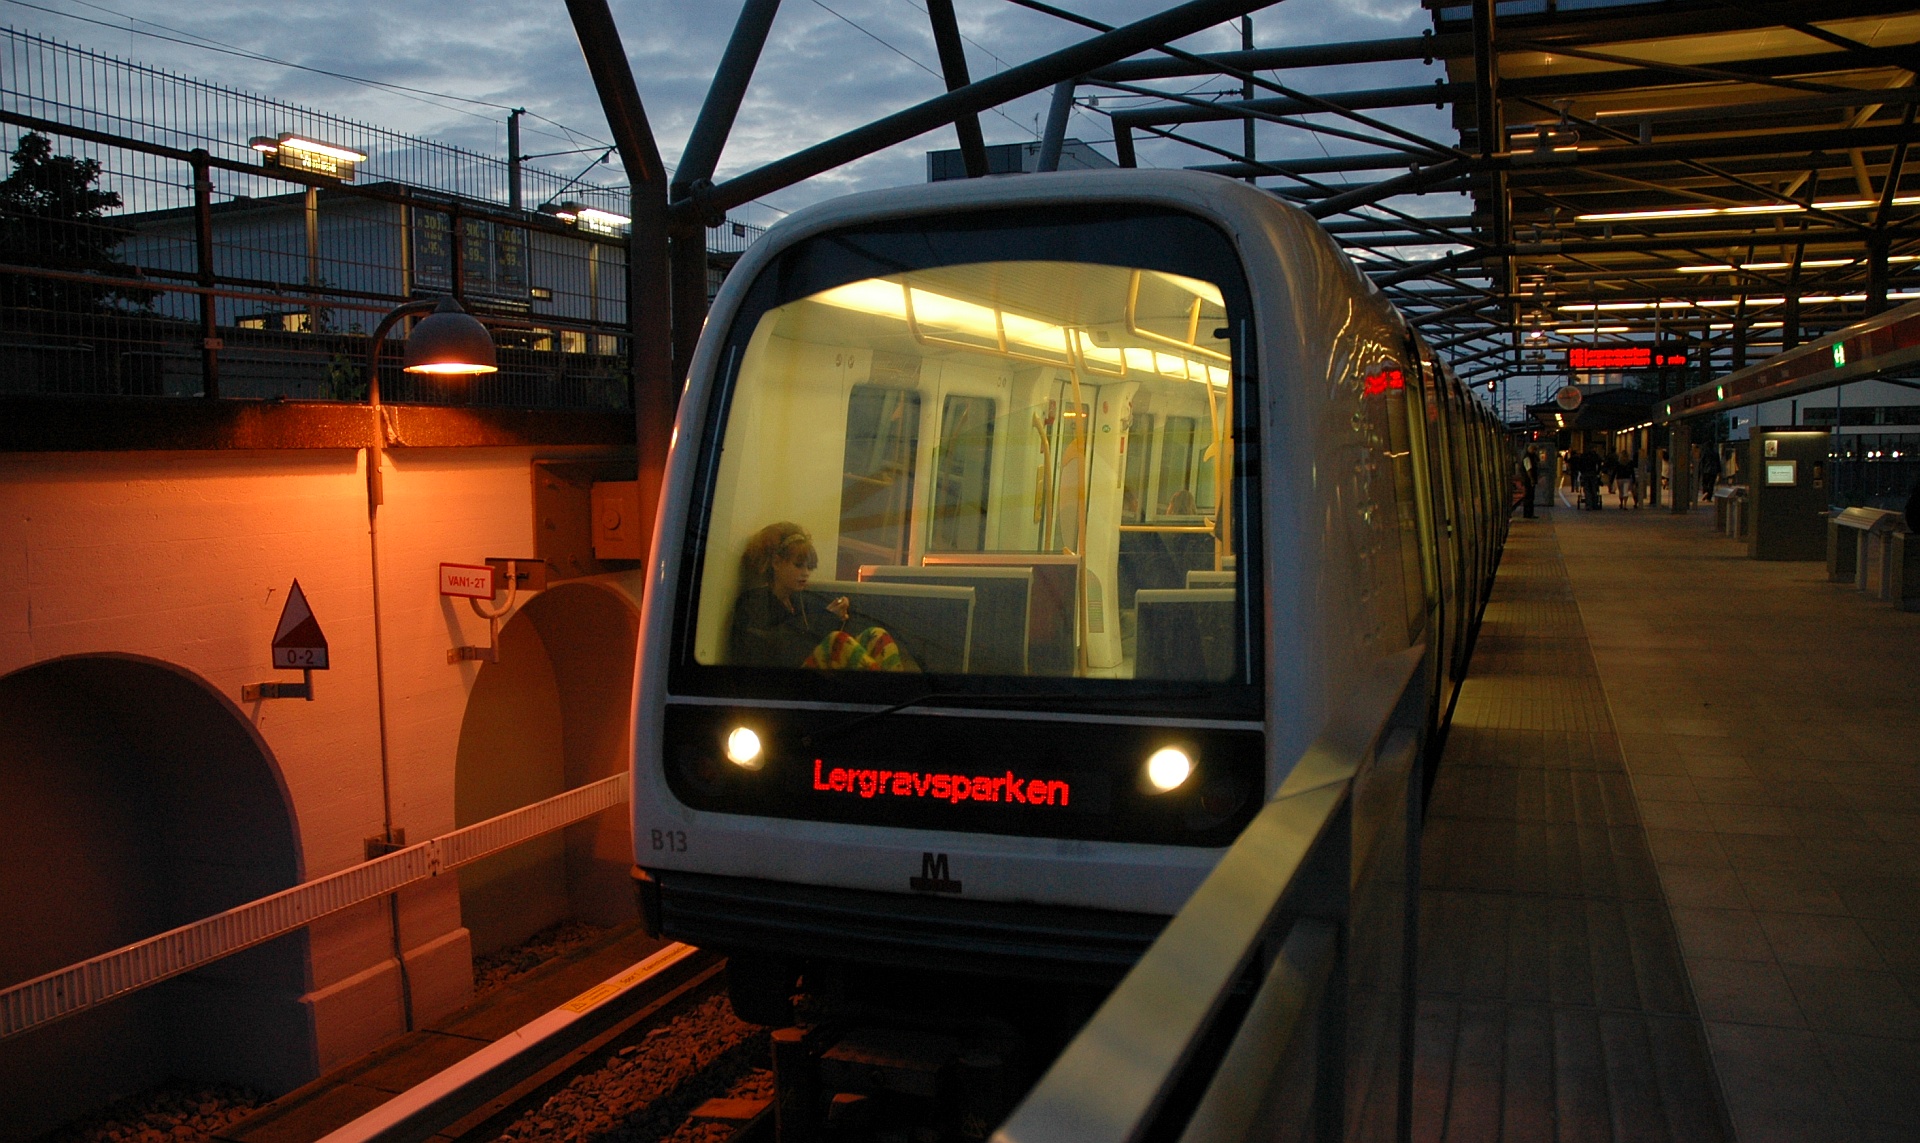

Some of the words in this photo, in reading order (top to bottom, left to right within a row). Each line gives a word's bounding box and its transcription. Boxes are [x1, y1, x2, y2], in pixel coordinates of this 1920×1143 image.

[447, 575, 485, 589] VAN1-2T
[287, 649, 314, 665] 0-2
[814, 759, 1069, 806] Lergravsparken
[651, 829, 687, 852] B13
